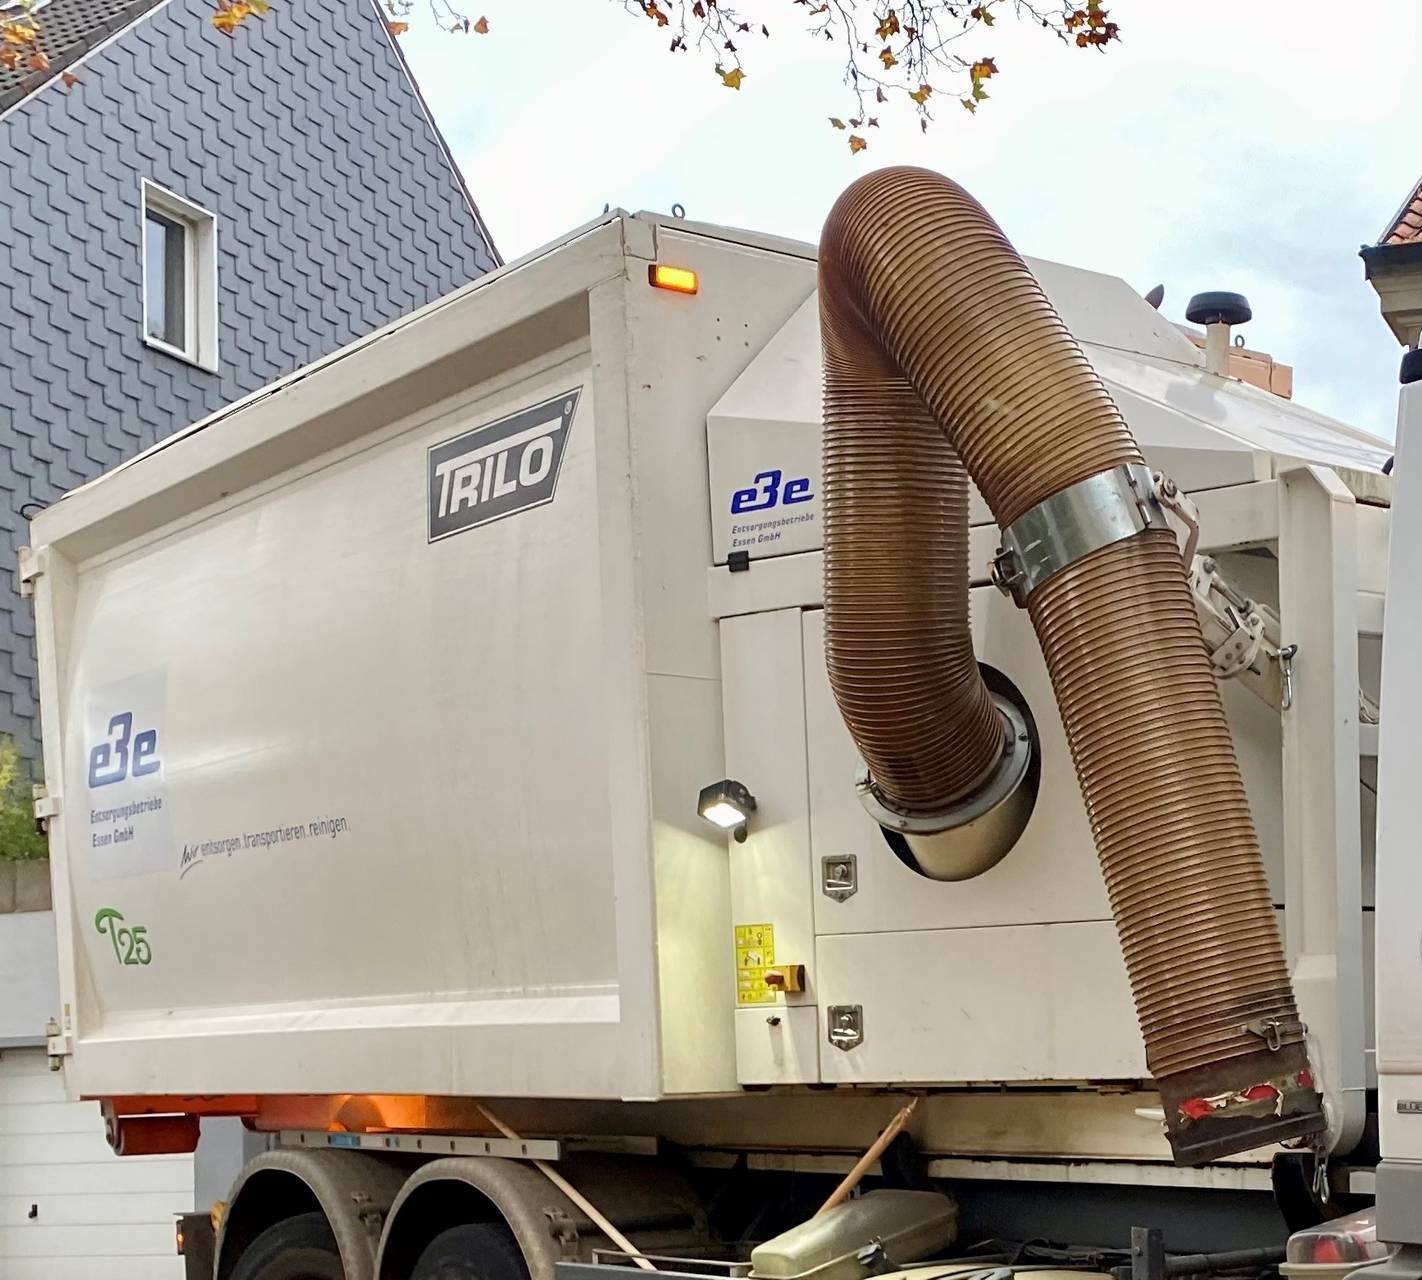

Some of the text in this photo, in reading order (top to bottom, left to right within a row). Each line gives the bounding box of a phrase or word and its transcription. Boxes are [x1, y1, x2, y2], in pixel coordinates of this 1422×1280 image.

[435, 416, 562, 518] TRILO
[731, 469, 814, 514] e3e
[732, 513, 815, 534] Entsorgungsbetriebe
[732, 532, 781, 547] Essen GmbH
[88, 711, 161, 788] e3e
[90, 797, 162, 824] Entsorgungsbetriebe
[92, 826, 134, 848] Essen GmbH
